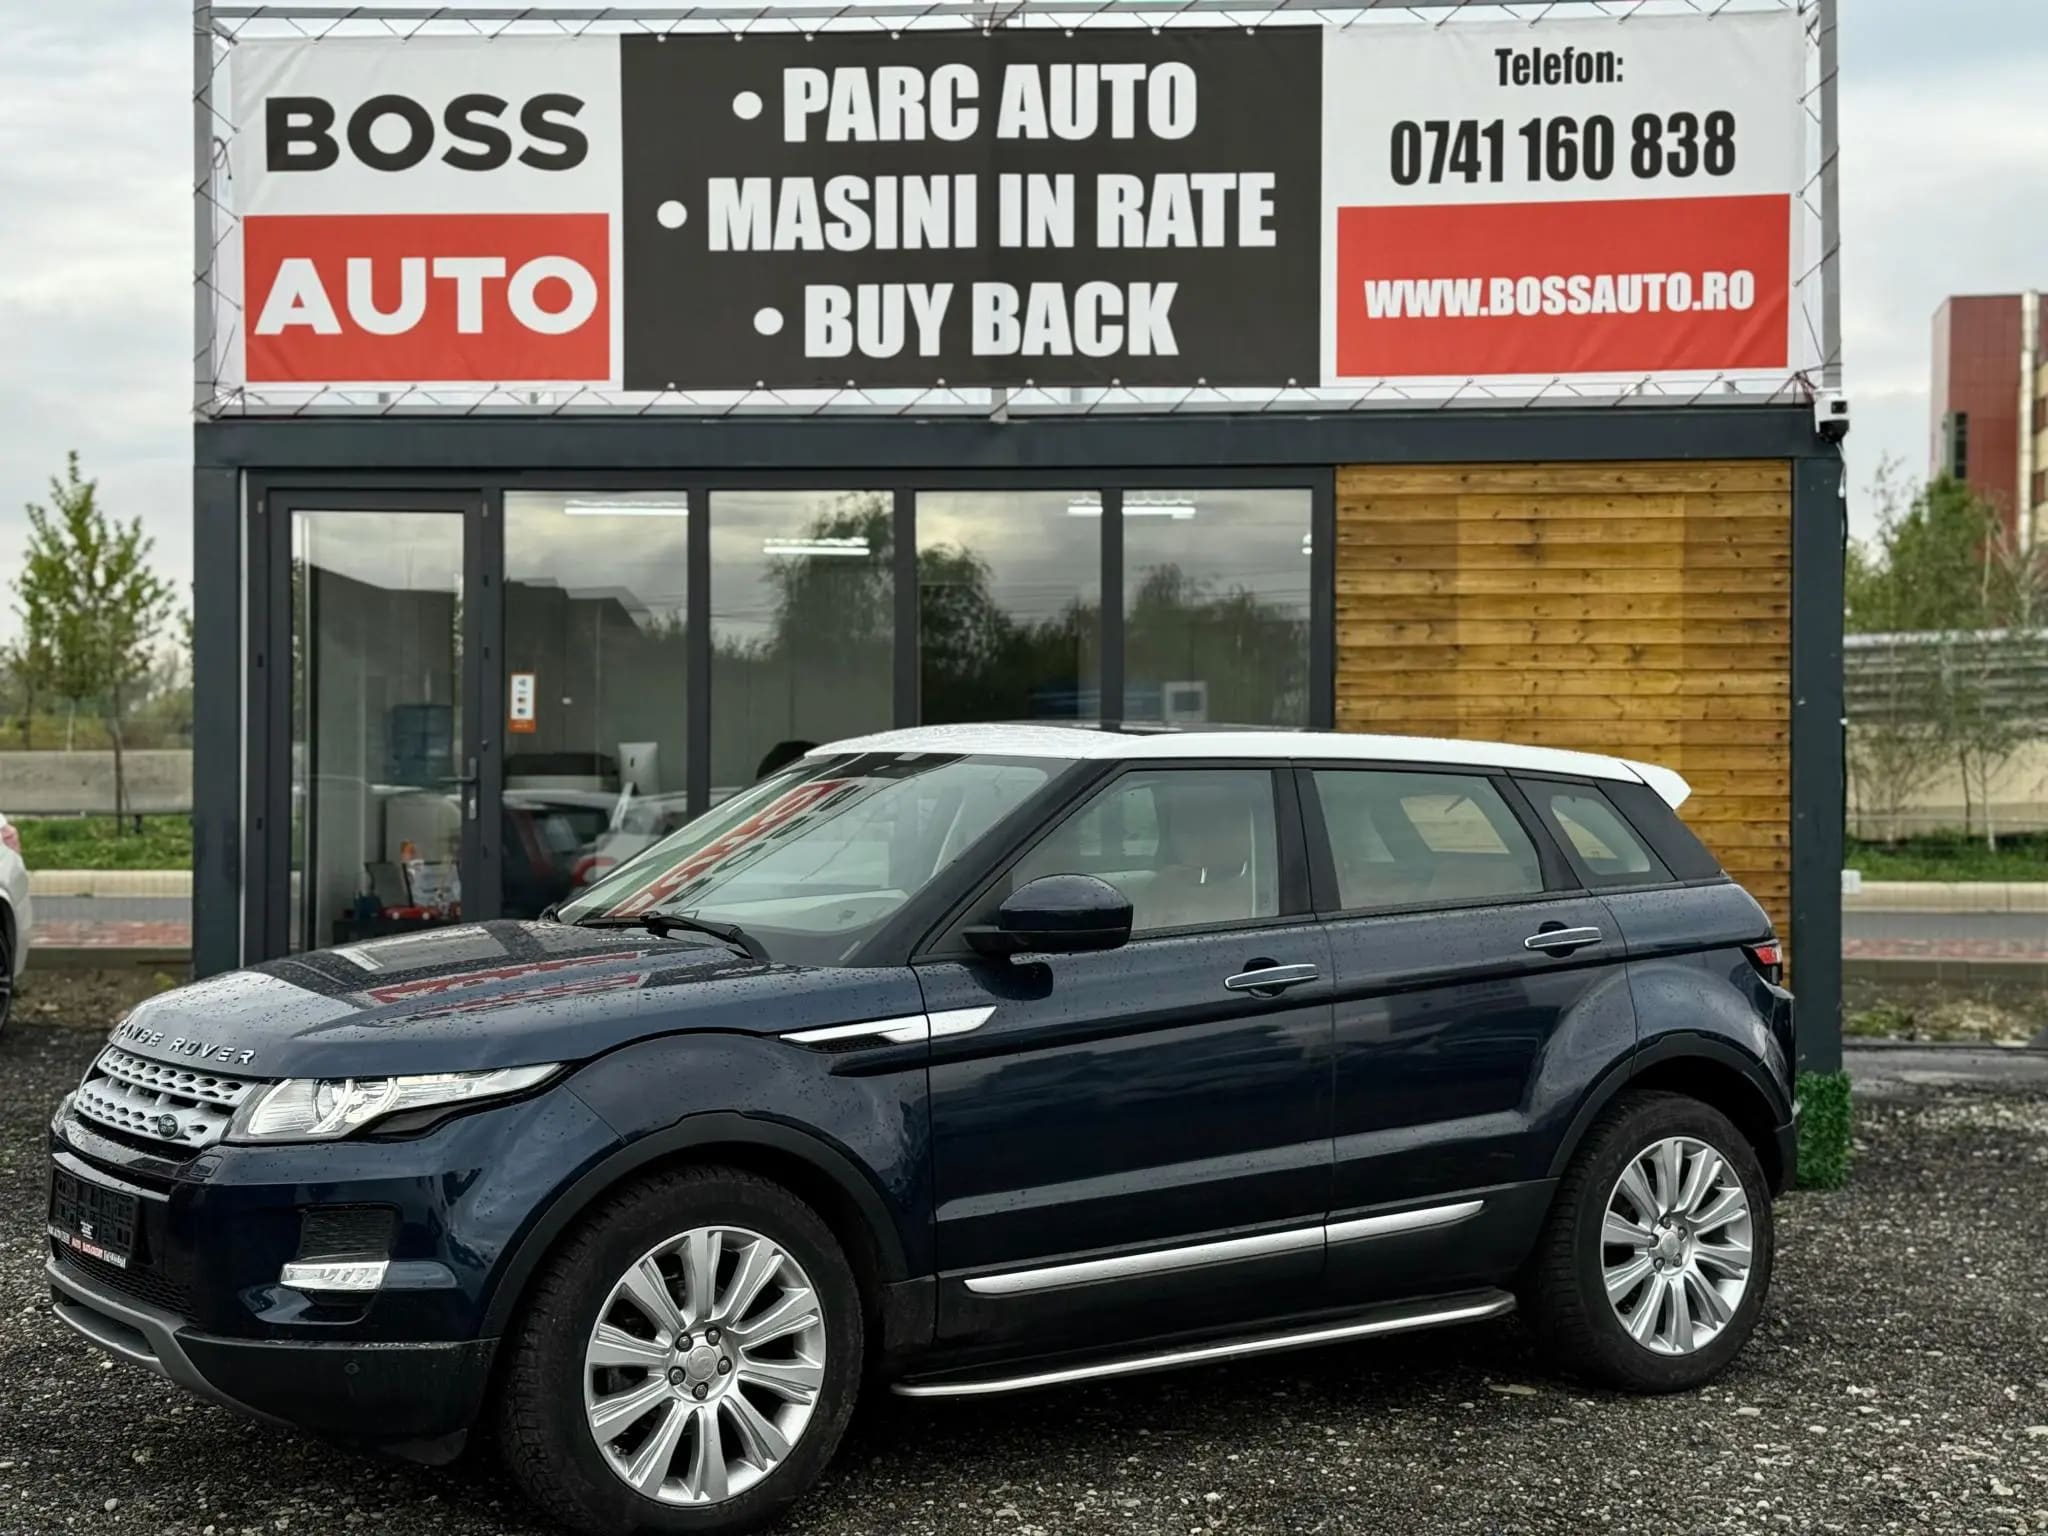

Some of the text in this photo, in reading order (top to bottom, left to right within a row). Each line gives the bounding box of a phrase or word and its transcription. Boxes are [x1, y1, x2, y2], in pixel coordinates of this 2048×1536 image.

[783, 61, 1197, 143] PARC AUTO
[1494, 46, 1625, 87] Telefon:
[265, 93, 589, 173] BOSS
[1390, 110, 1736, 186] 0741 160 838
[707, 172, 1277, 252] MASINI IN RATE
[254, 255, 598, 336] AUTO
[804, 280, 1180, 359] BUY BACK
[1364, 270, 1755, 319] WWW.BOSSAUTO.RO
[169, 1037, 256, 1066] ROVER
